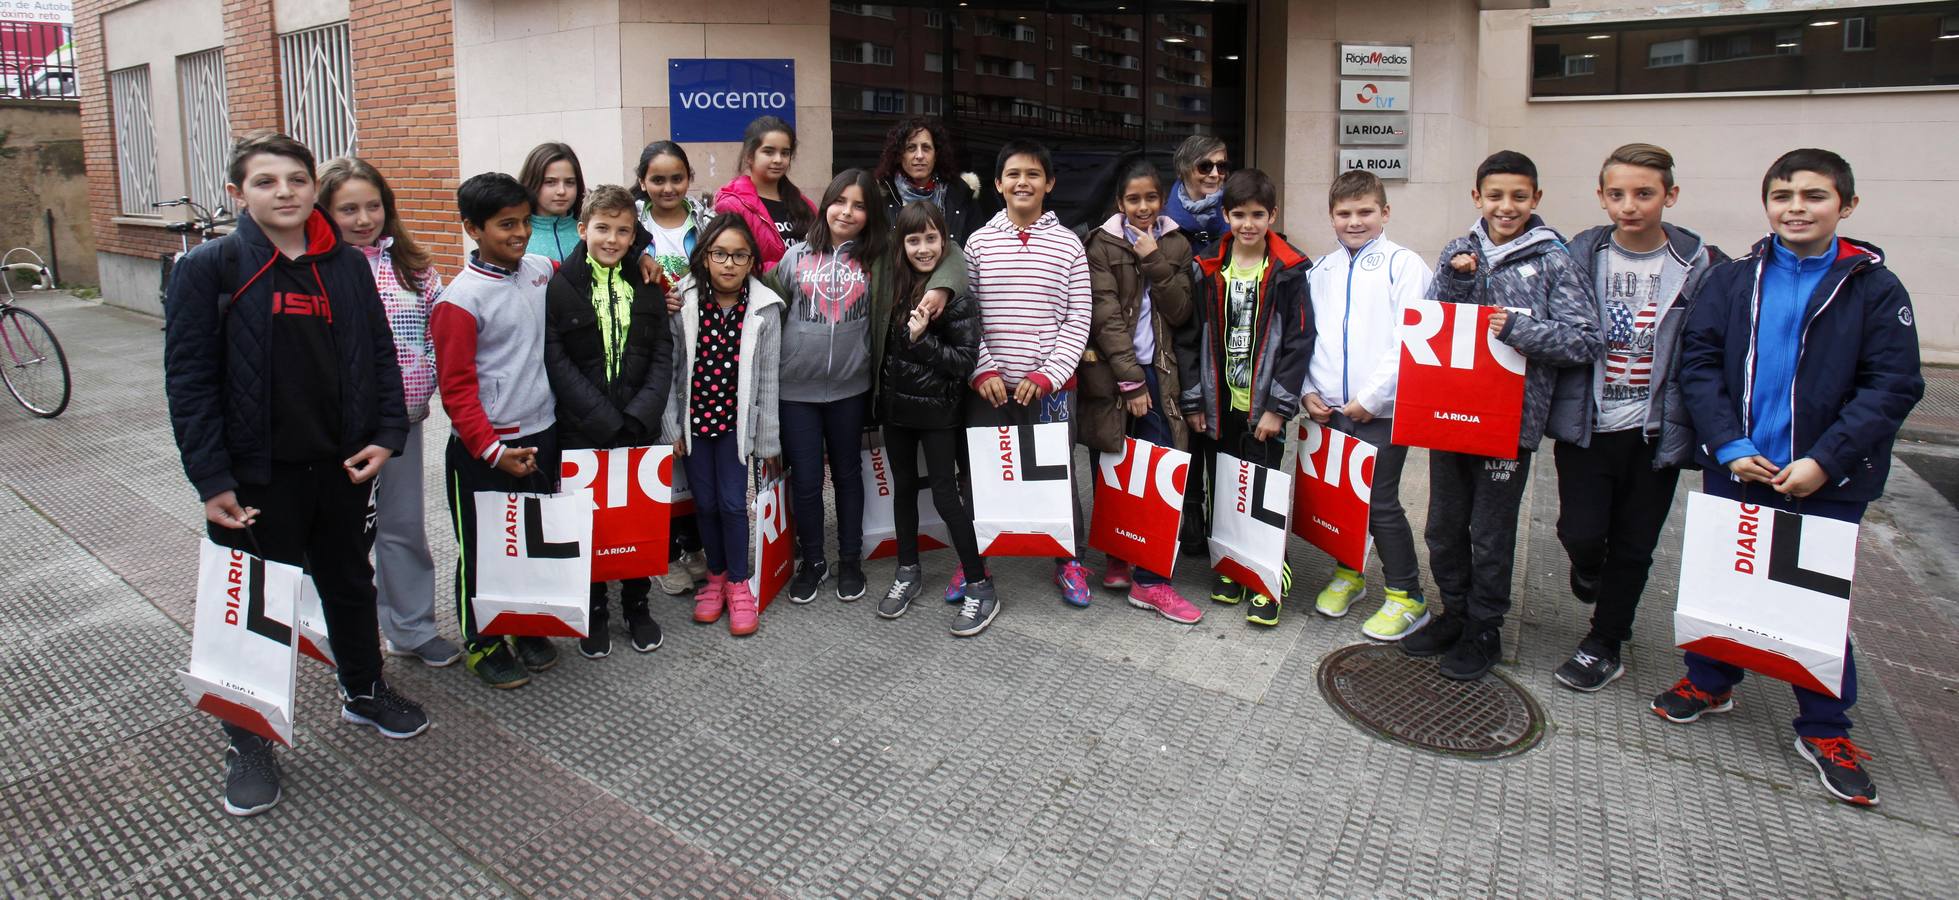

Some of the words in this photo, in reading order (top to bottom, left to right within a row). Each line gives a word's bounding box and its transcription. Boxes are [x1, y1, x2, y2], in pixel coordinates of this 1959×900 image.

[680, 92, 786, 109] vocento
[1376, 95, 1394, 108] tvr
[1346, 125, 1360, 134] LA
[1362, 125, 1394, 135] RIOJA
[1348, 159, 1363, 169] LA
[1367, 159, 1401, 169] RIOJA
[837, 267, 865, 285] Rock
[1437, 411, 1450, 420] LA
[1450, 413, 1480, 424] RIOJA
[1116, 527, 1126, 537] LA
[1125, 531, 1147, 544] RIOJA
[599, 548, 610, 556] LA
[610, 545, 637, 555] RIOJA
